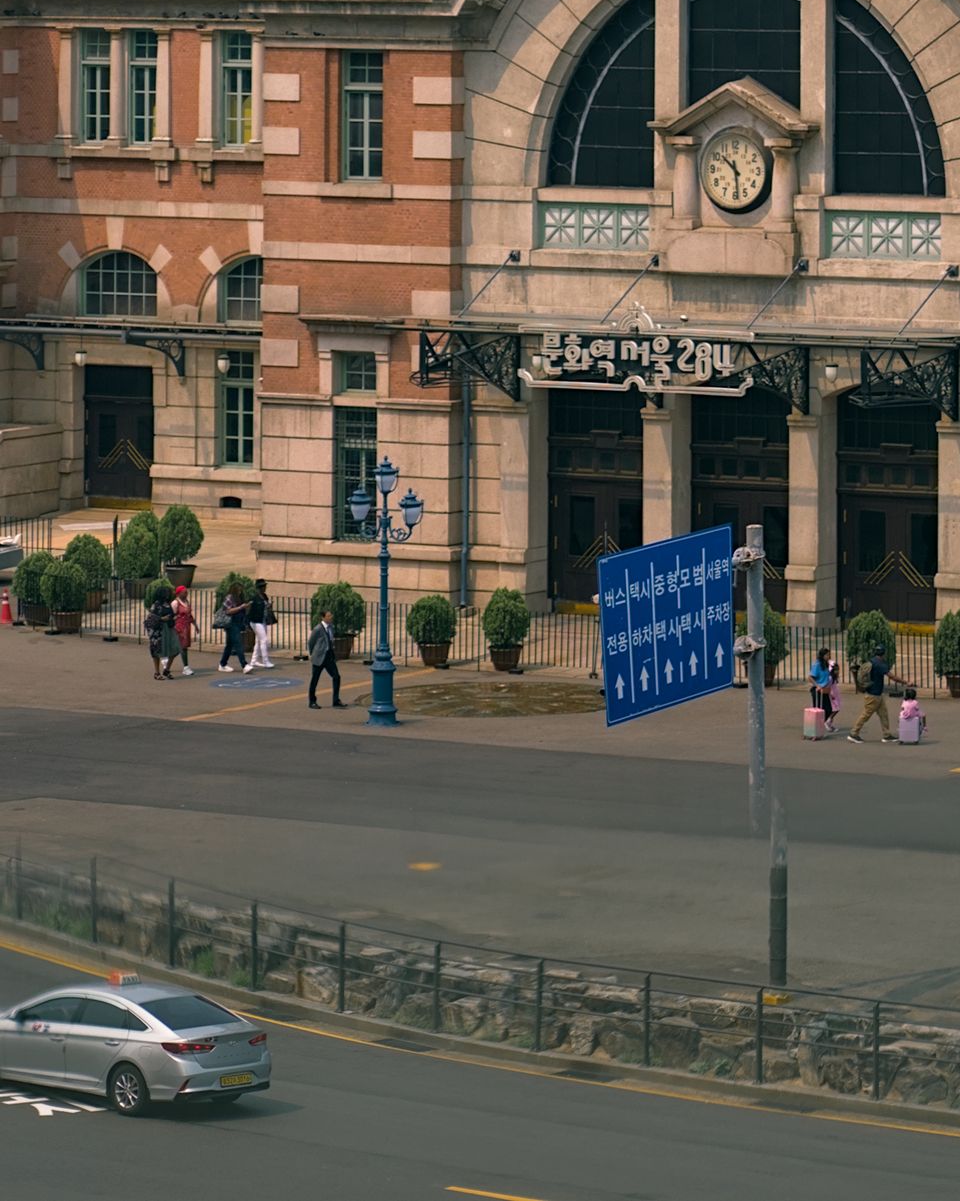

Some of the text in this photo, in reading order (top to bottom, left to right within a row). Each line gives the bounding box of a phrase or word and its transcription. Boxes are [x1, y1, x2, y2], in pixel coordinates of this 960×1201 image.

[705, 557, 729, 581] 서울역
[604, 588, 626, 609] 버스
[629, 578, 651, 602] 택시
[680, 608, 705, 635] 택시
[706, 601, 730, 626] 주차장
[631, 623, 653, 647] 하차
[655, 615, 680, 642] 택시
[606, 631, 628, 656] 전용
